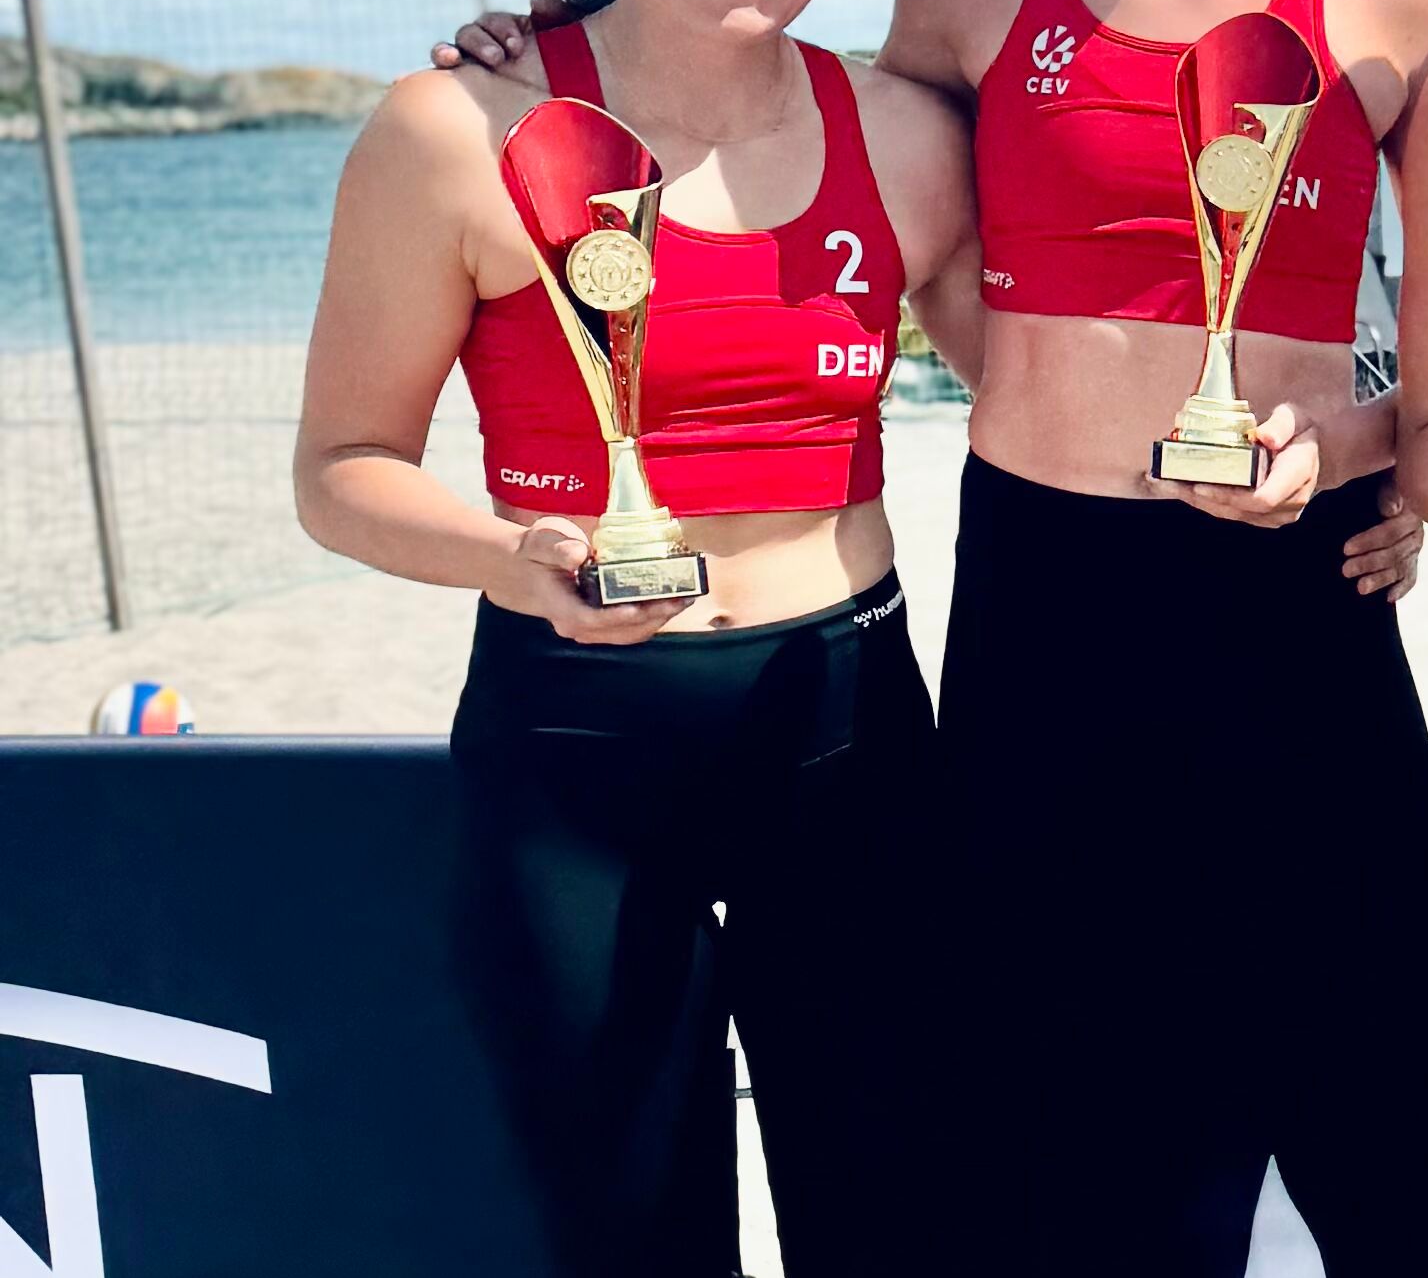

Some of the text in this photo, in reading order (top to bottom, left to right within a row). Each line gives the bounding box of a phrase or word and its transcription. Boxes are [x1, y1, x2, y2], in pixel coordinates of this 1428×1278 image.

[1026, 76, 1070, 95] CEV
[825, 230, 870, 294] 2
[817, 343, 885, 377] DEN
[500, 468, 566, 491] CRAFT
